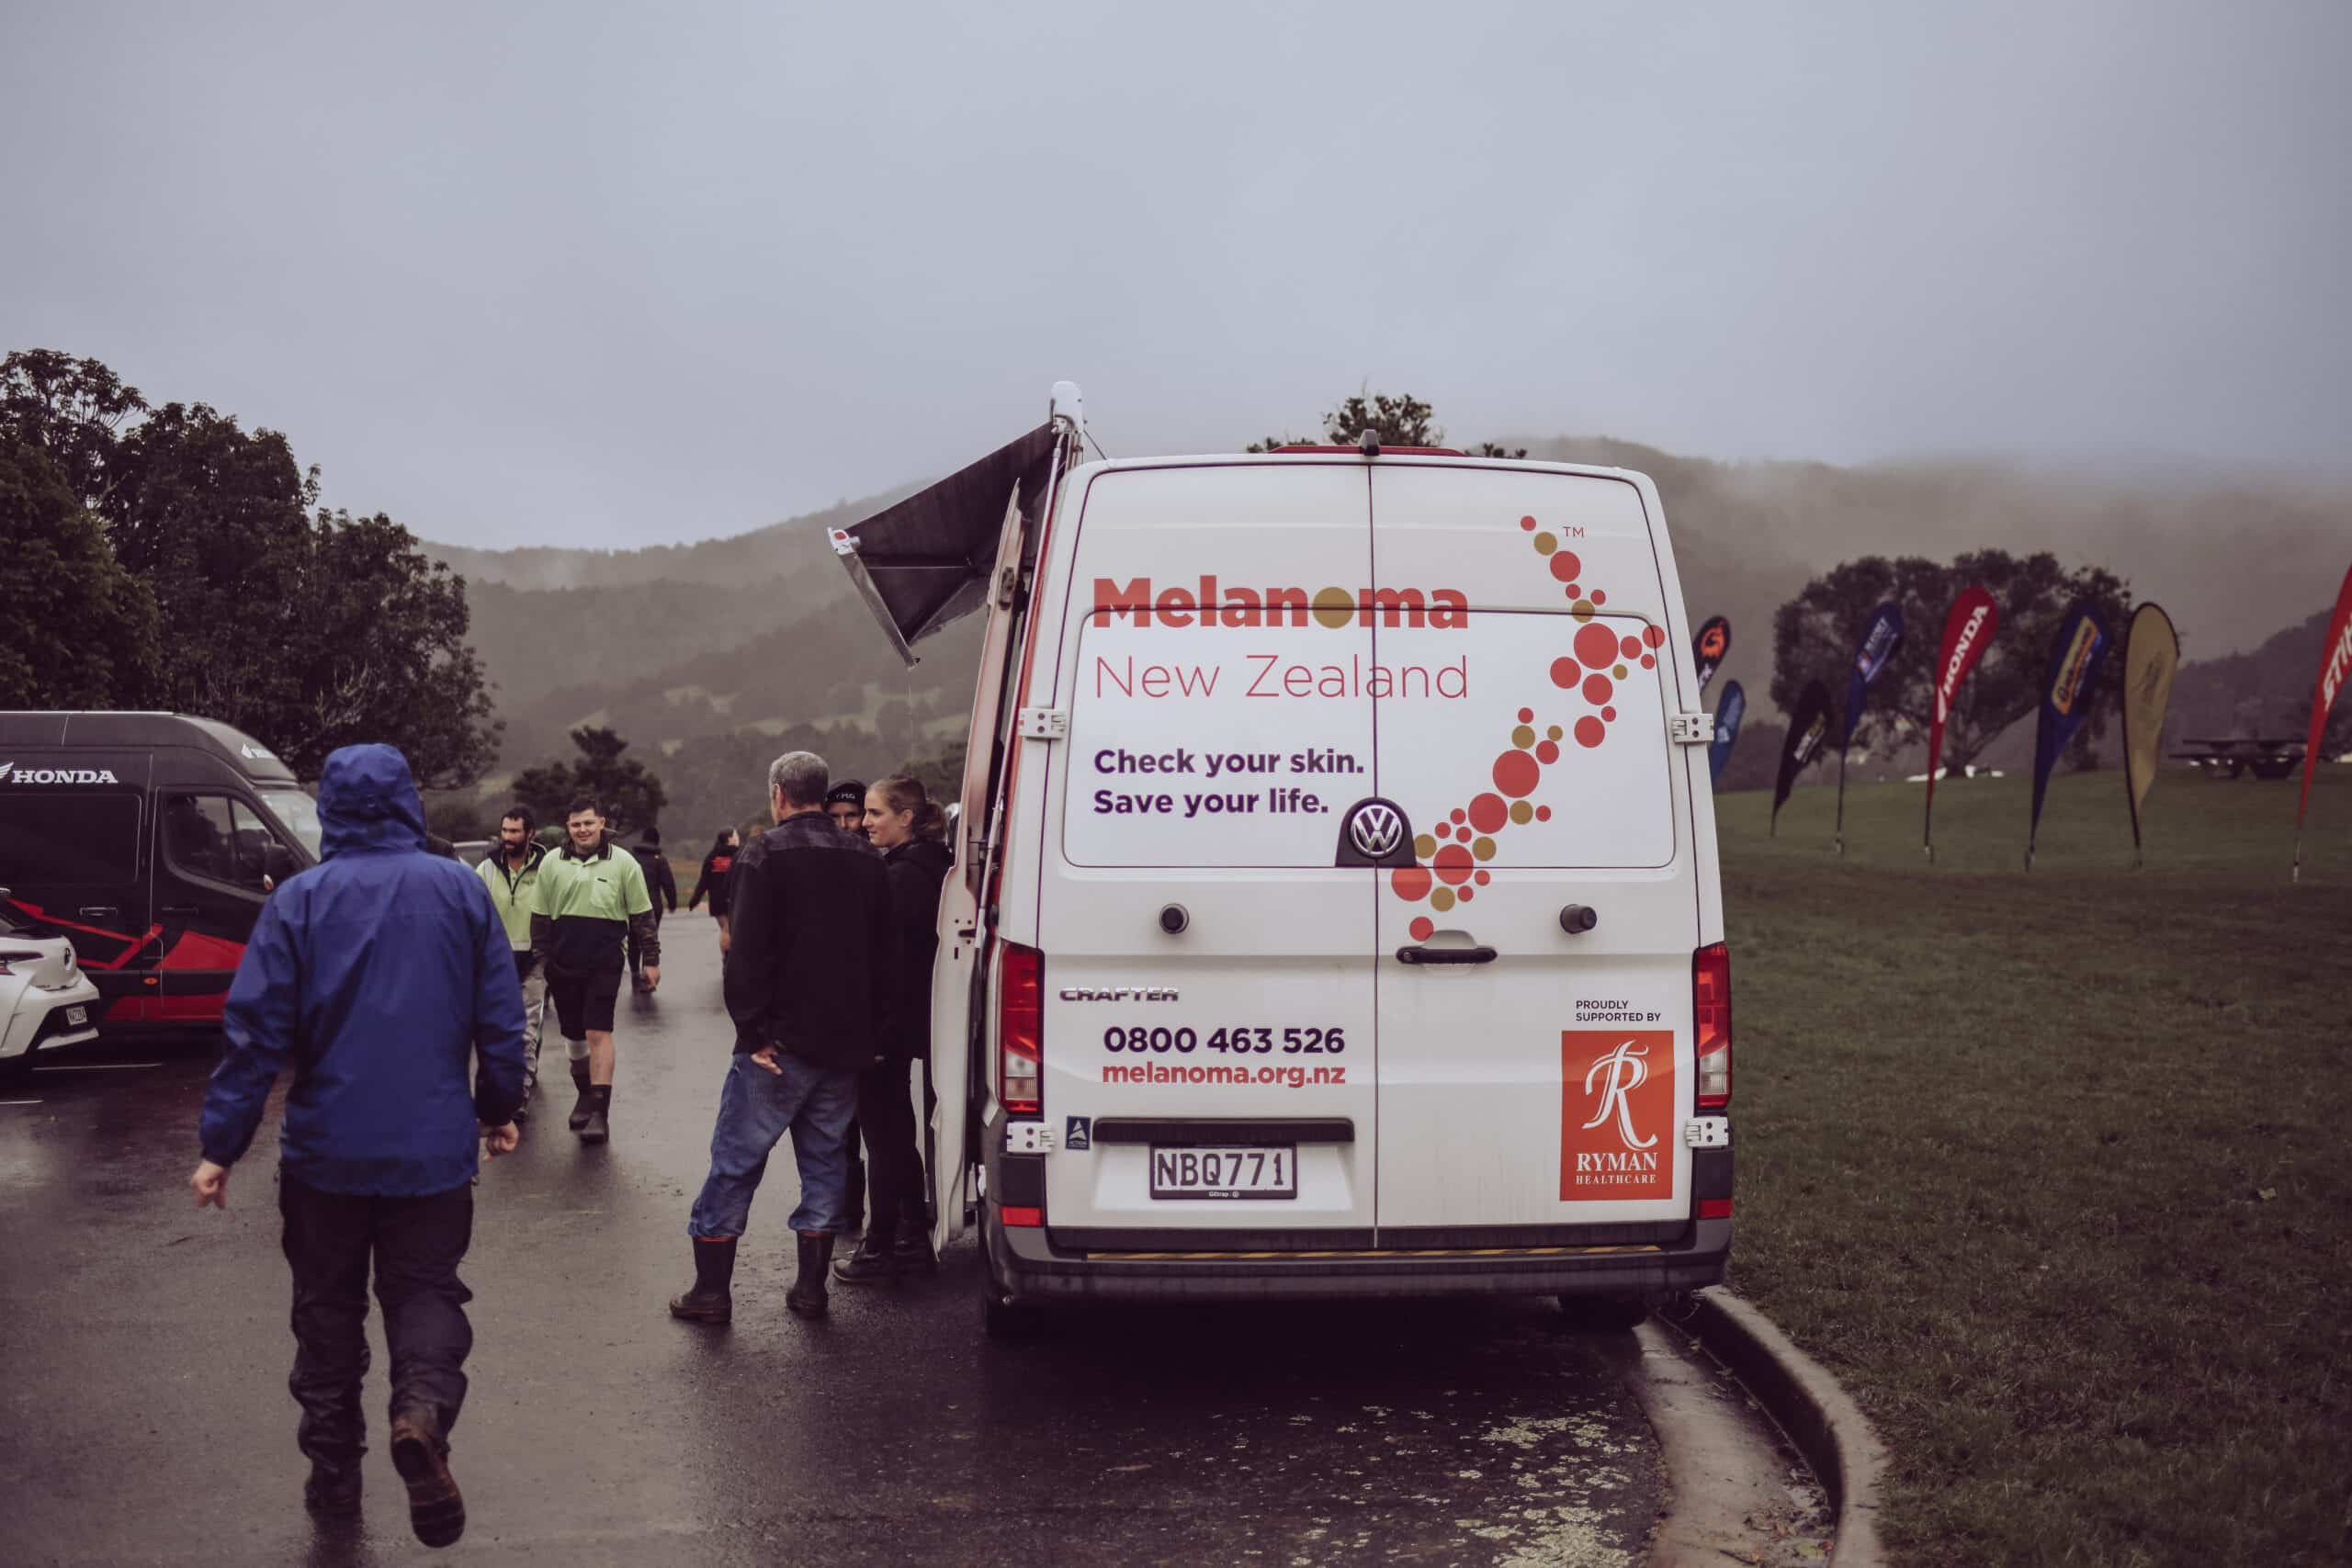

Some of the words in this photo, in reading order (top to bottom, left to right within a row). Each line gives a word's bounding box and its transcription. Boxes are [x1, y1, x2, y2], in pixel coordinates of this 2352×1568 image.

[1563, 525, 1586, 537] TM
[1093, 575, 1468, 629] Melanoma
[1943, 605, 1989, 697] HONDA
[1096, 655, 1220, 698] New
[1245, 653, 1468, 699] Zealand
[11, 769, 119, 784] HONDA
[1094, 748, 1195, 774] Check
[1204, 753, 1281, 778] your
[1290, 748, 1364, 774] skin.
[1093, 789, 1173, 814] Save
[1182, 794, 1260, 818] your
[1269, 787, 1329, 814] life.
[1059, 987, 1179, 1001] CRAFTER
[1576, 1000, 1629, 1010] PROUDLY
[1576, 1012, 1644, 1021] SUPPORTED
[1646, 1012, 1661, 1021] BY
[1103, 1026, 1197, 1054] 0800
[1206, 1027, 1272, 1054] 463
[1283, 1027, 1345, 1054] 526
[1102, 1062, 1346, 1089] melanoma.org.nz
[1157, 1153, 1283, 1187] NBQ771
[1577, 1152, 1658, 1172] RYMAN
[1576, 1174, 1656, 1184] HEALTHCARE
